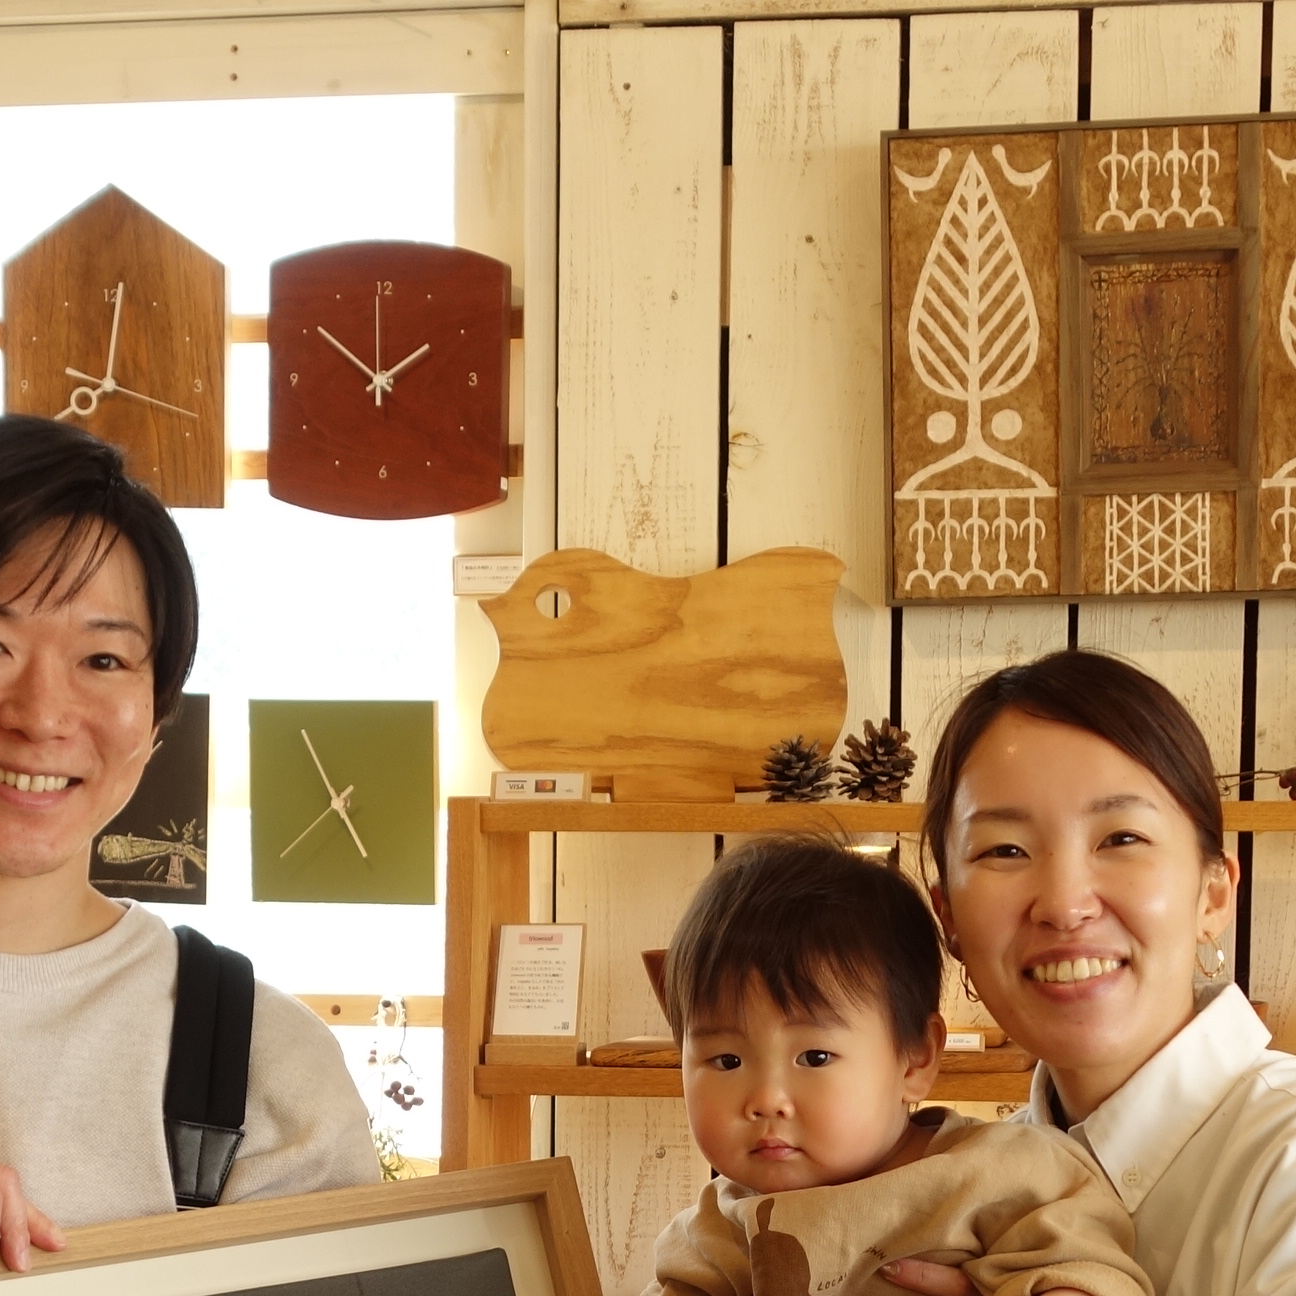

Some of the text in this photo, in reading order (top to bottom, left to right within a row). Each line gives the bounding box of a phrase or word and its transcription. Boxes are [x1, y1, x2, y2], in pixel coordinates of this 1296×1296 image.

[376, 281, 393, 295] 12
[194, 379, 203, 393] 3
[290, 373, 298, 387] 9
[468, 372, 477, 386] 3
[20, 380, 28, 394] 9
[379, 464, 387, 479] 6
